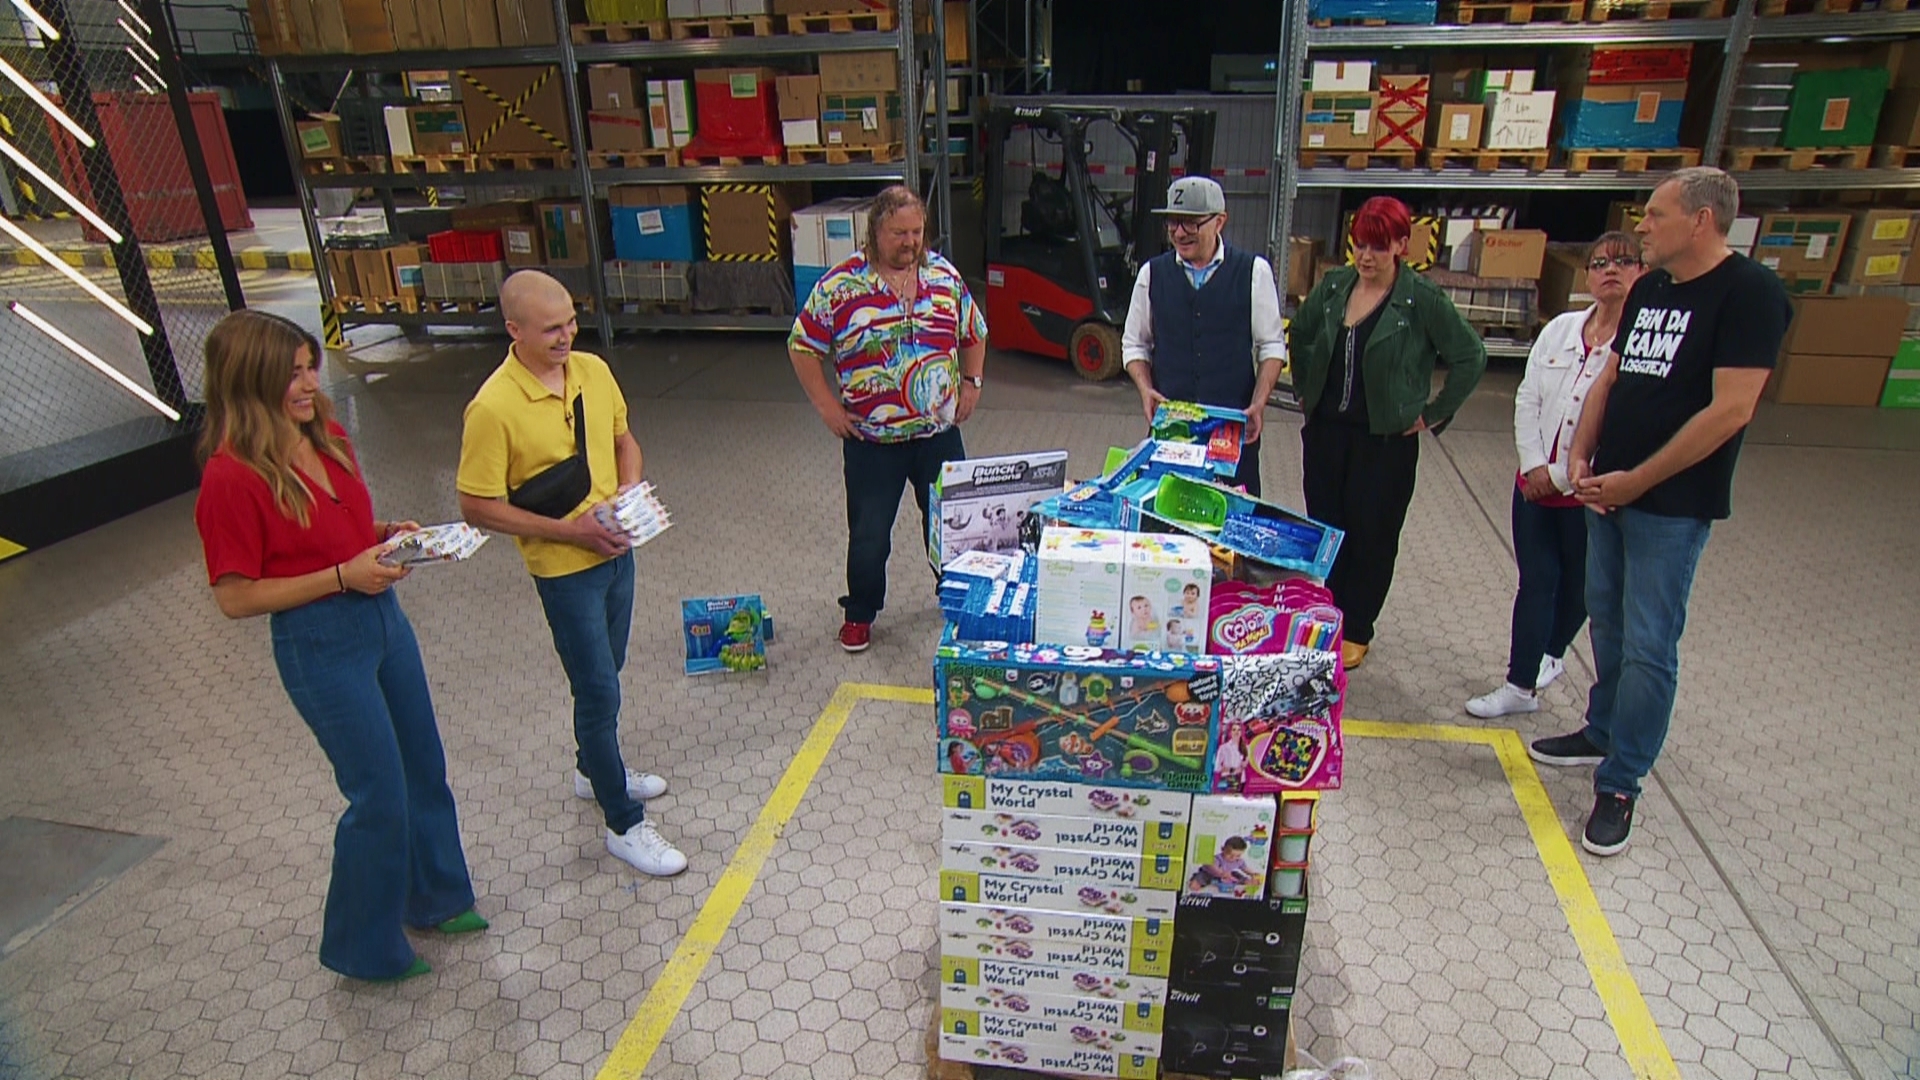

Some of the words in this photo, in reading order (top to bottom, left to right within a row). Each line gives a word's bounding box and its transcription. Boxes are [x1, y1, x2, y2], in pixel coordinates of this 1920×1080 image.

[1173, 189, 1184, 205] Z
[1665, 309, 1692, 333] DA
[1623, 329, 1684, 361] KANN
[991, 783, 1013, 796] My
[1018, 784, 1073, 798] Crystal
[991, 796, 1036, 808] World
[1093, 823, 1138, 836] World
[1055, 832, 1110, 846] Crystal
[1115, 835, 1137, 848] My
[1090, 857, 1135, 870] World
[1054, 866, 1108, 880] Crystal
[1112, 868, 1135, 882] My
[985, 879, 1006, 892] My
[1010, 881, 1063, 895] Crystal
[985, 890, 1028, 903] World
[1083, 919, 1127, 932] World
[1048, 927, 1099, 940] Crystal
[1104, 930, 1126, 943] My
[1082, 945, 1125, 957] World
[1047, 952, 1098, 966] Crystal
[1103, 956, 1124, 969] My
[984, 963, 1005, 976] My
[1008, 966, 1060, 980] Crystal
[984, 974, 1025, 986] World
[1043, 1006, 1093, 1021] Crystal
[1077, 1000, 1118, 1014] World
[984, 1015, 1004, 1028] My
[1008, 1018, 1057, 1032] Crystal
[1097, 1012, 1118, 1024] My
[984, 1025, 1025, 1038] World
[1073, 1051, 1114, 1063] World
[1041, 1058, 1089, 1072] Crystal
[1093, 1061, 1114, 1073] My
